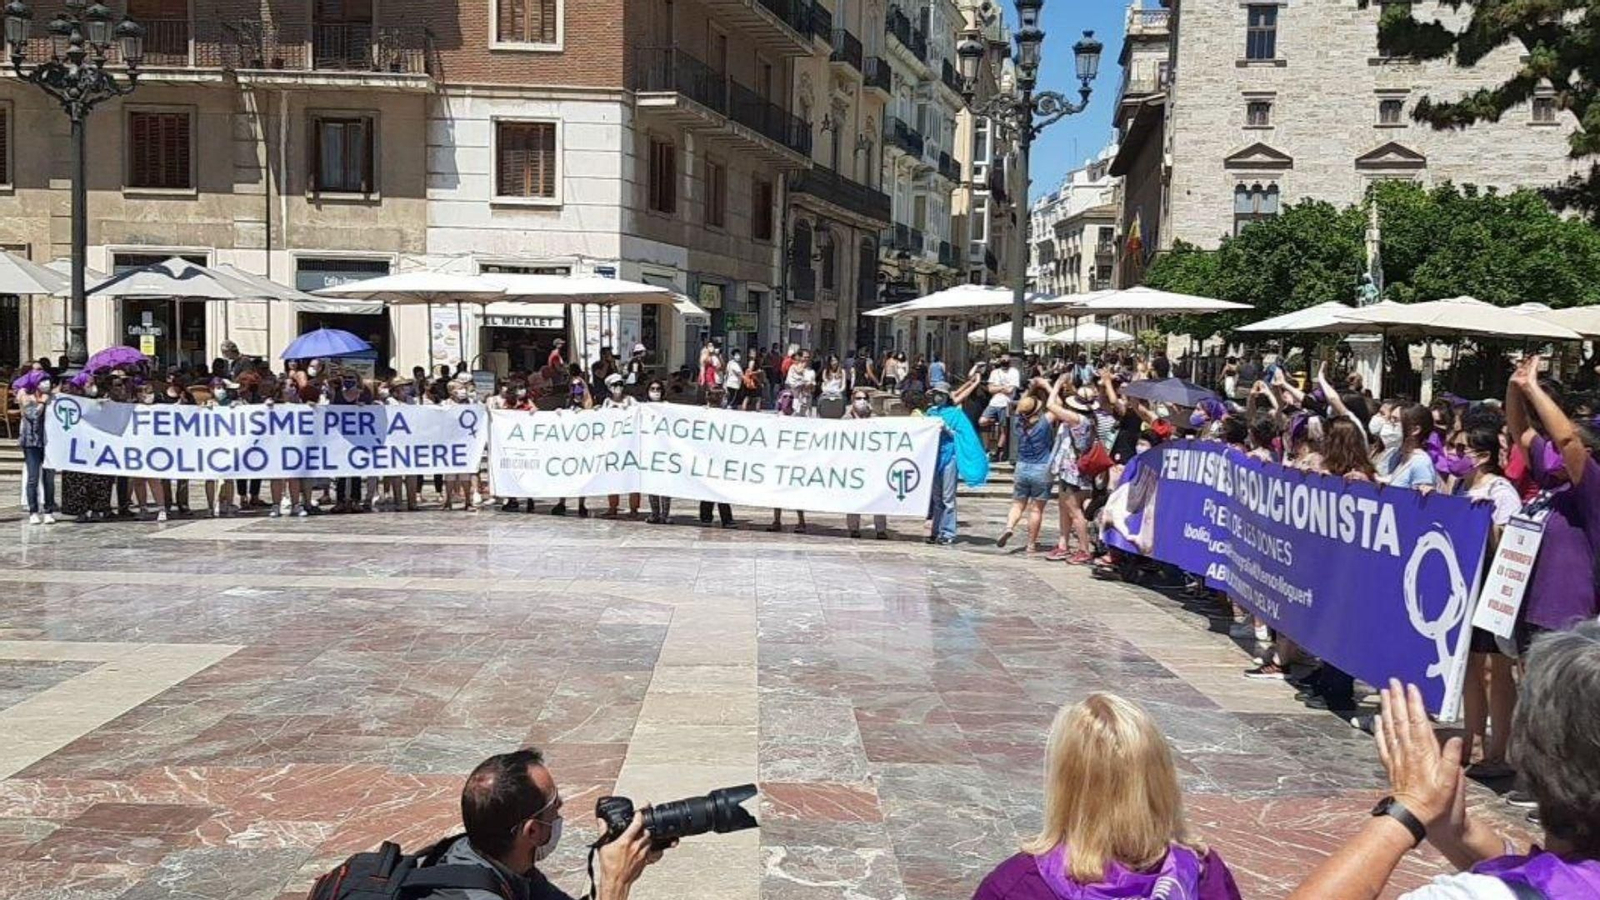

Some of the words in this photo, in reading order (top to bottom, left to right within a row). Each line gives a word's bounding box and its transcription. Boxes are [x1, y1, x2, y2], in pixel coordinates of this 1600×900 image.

[502, 316, 552, 327] MICALET
[132, 410, 314, 437] FEMINISME
[324, 411, 376, 436] PER
[387, 411, 412, 435] A
[507, 423, 525, 441] A
[532, 422, 606, 442] FAVOR
[639, 414, 767, 448] L'AGENDA
[776, 429, 914, 452] FEMINISTA
[69, 437, 269, 472] L'ABOLICIÓ
[281, 446, 338, 471] DEL
[347, 437, 467, 470] GÈNERE
[545, 449, 641, 476] CONTRA
[690, 456, 766, 485] LLEIS
[774, 464, 865, 490] TRANS
